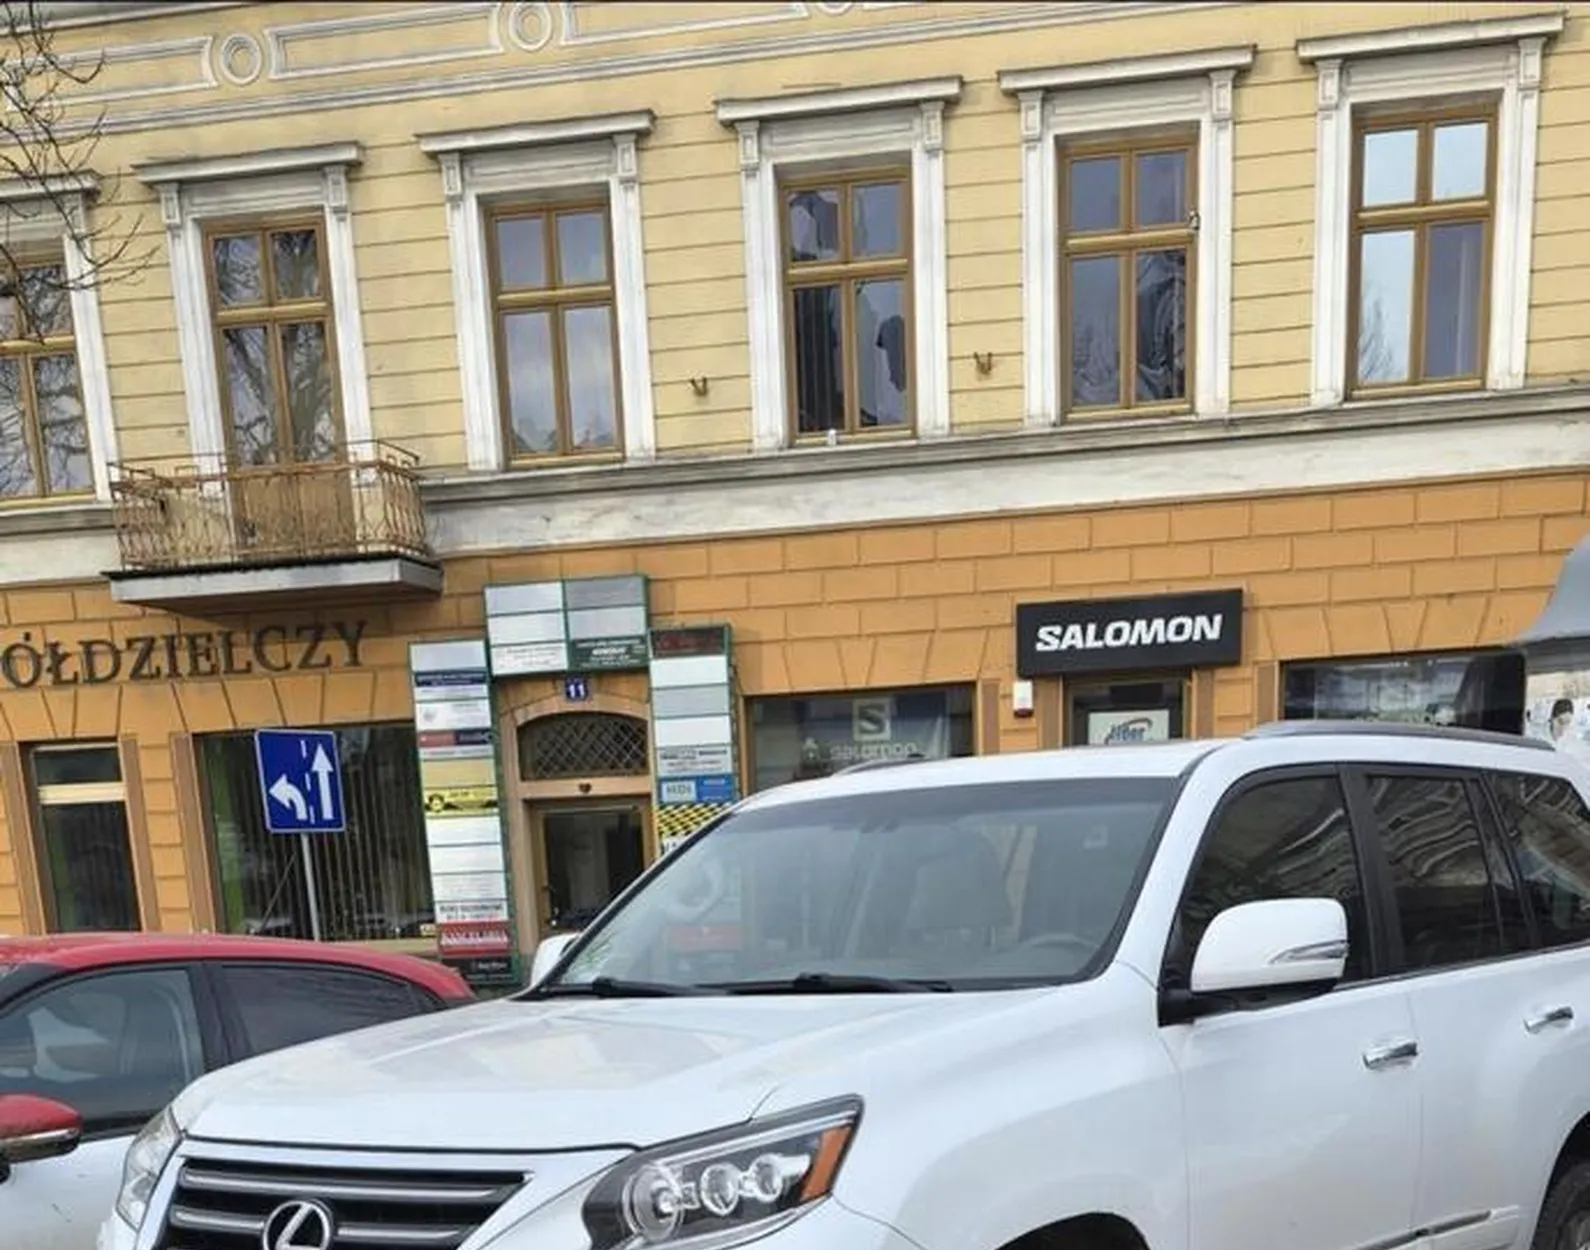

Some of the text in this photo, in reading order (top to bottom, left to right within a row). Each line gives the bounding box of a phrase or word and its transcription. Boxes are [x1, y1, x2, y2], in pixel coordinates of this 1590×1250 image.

[1035, 613, 1223, 652] SALOMON
[1, 620, 368, 689] ÓŁDZIELCZY
[568, 683, 586, 699] 11
